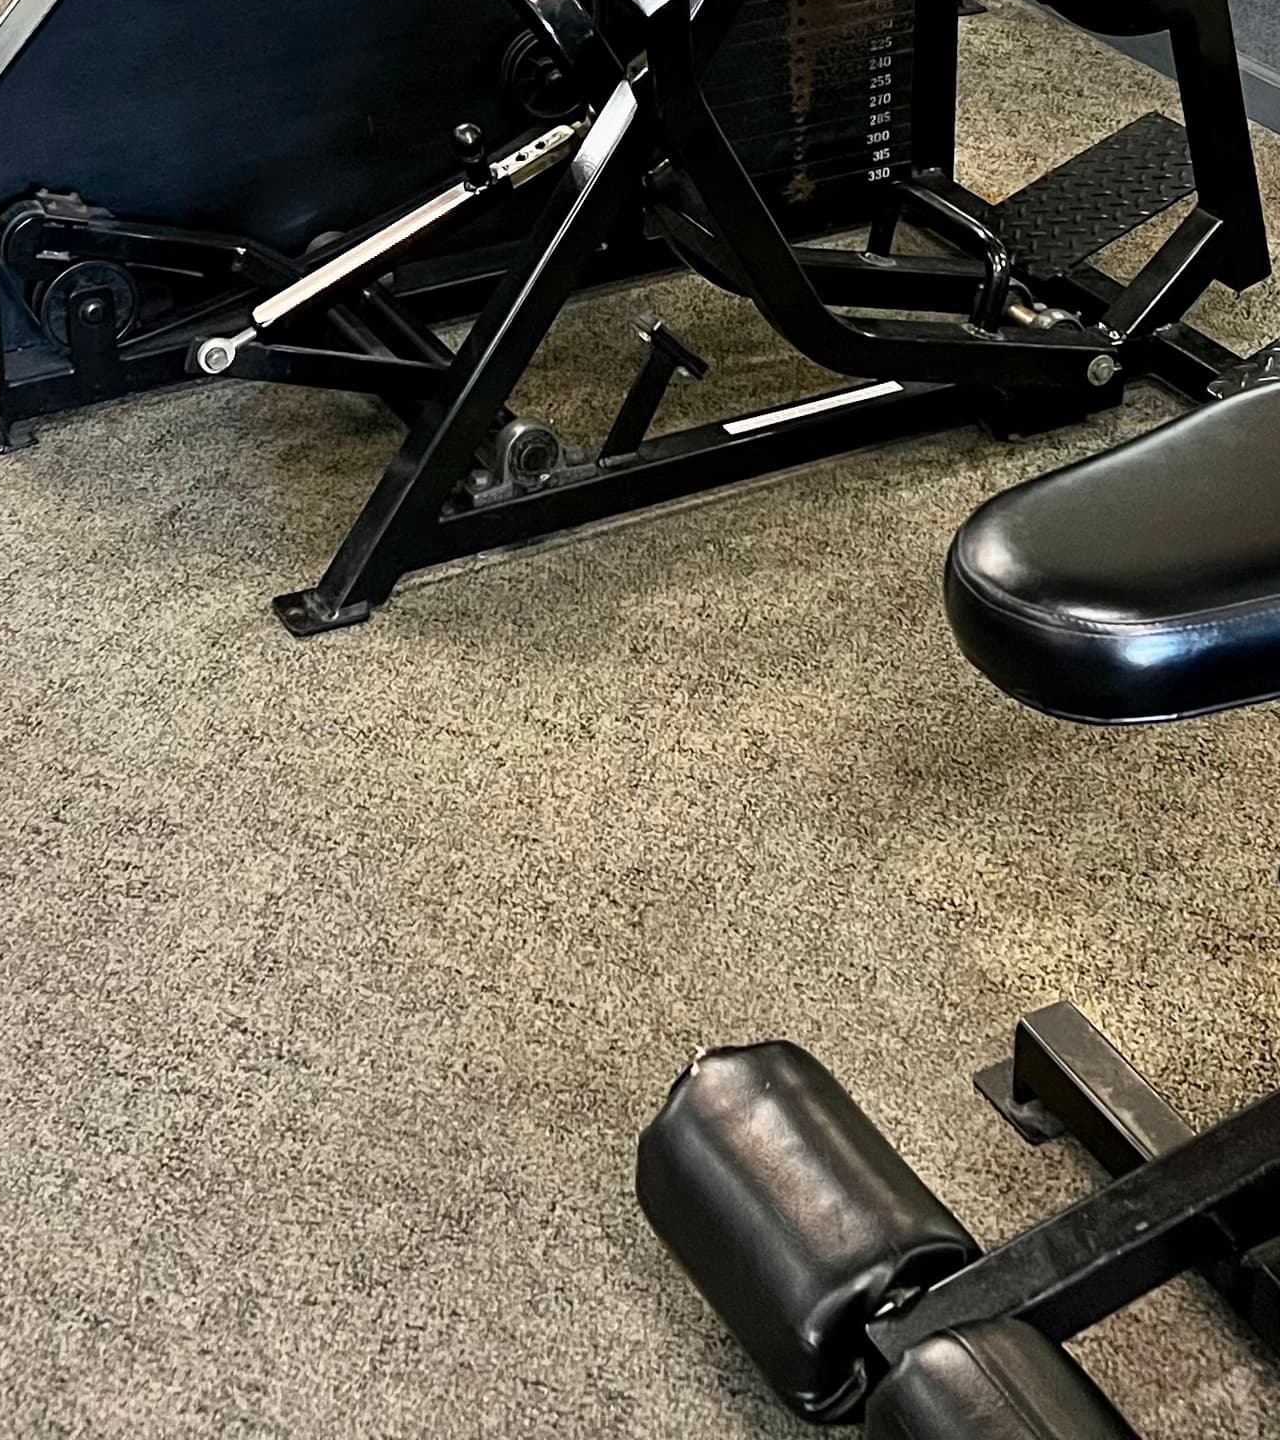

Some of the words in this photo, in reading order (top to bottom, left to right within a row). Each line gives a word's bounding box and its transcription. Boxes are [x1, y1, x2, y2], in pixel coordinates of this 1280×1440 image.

[869, 56, 891, 70] 240
[870, 74, 892, 89] 255
[869, 93, 891, 108] 270
[869, 111, 891, 126] 285
[866, 130, 890, 145] 300
[873, 148, 890, 162] 315
[868, 167, 890, 182] 330
